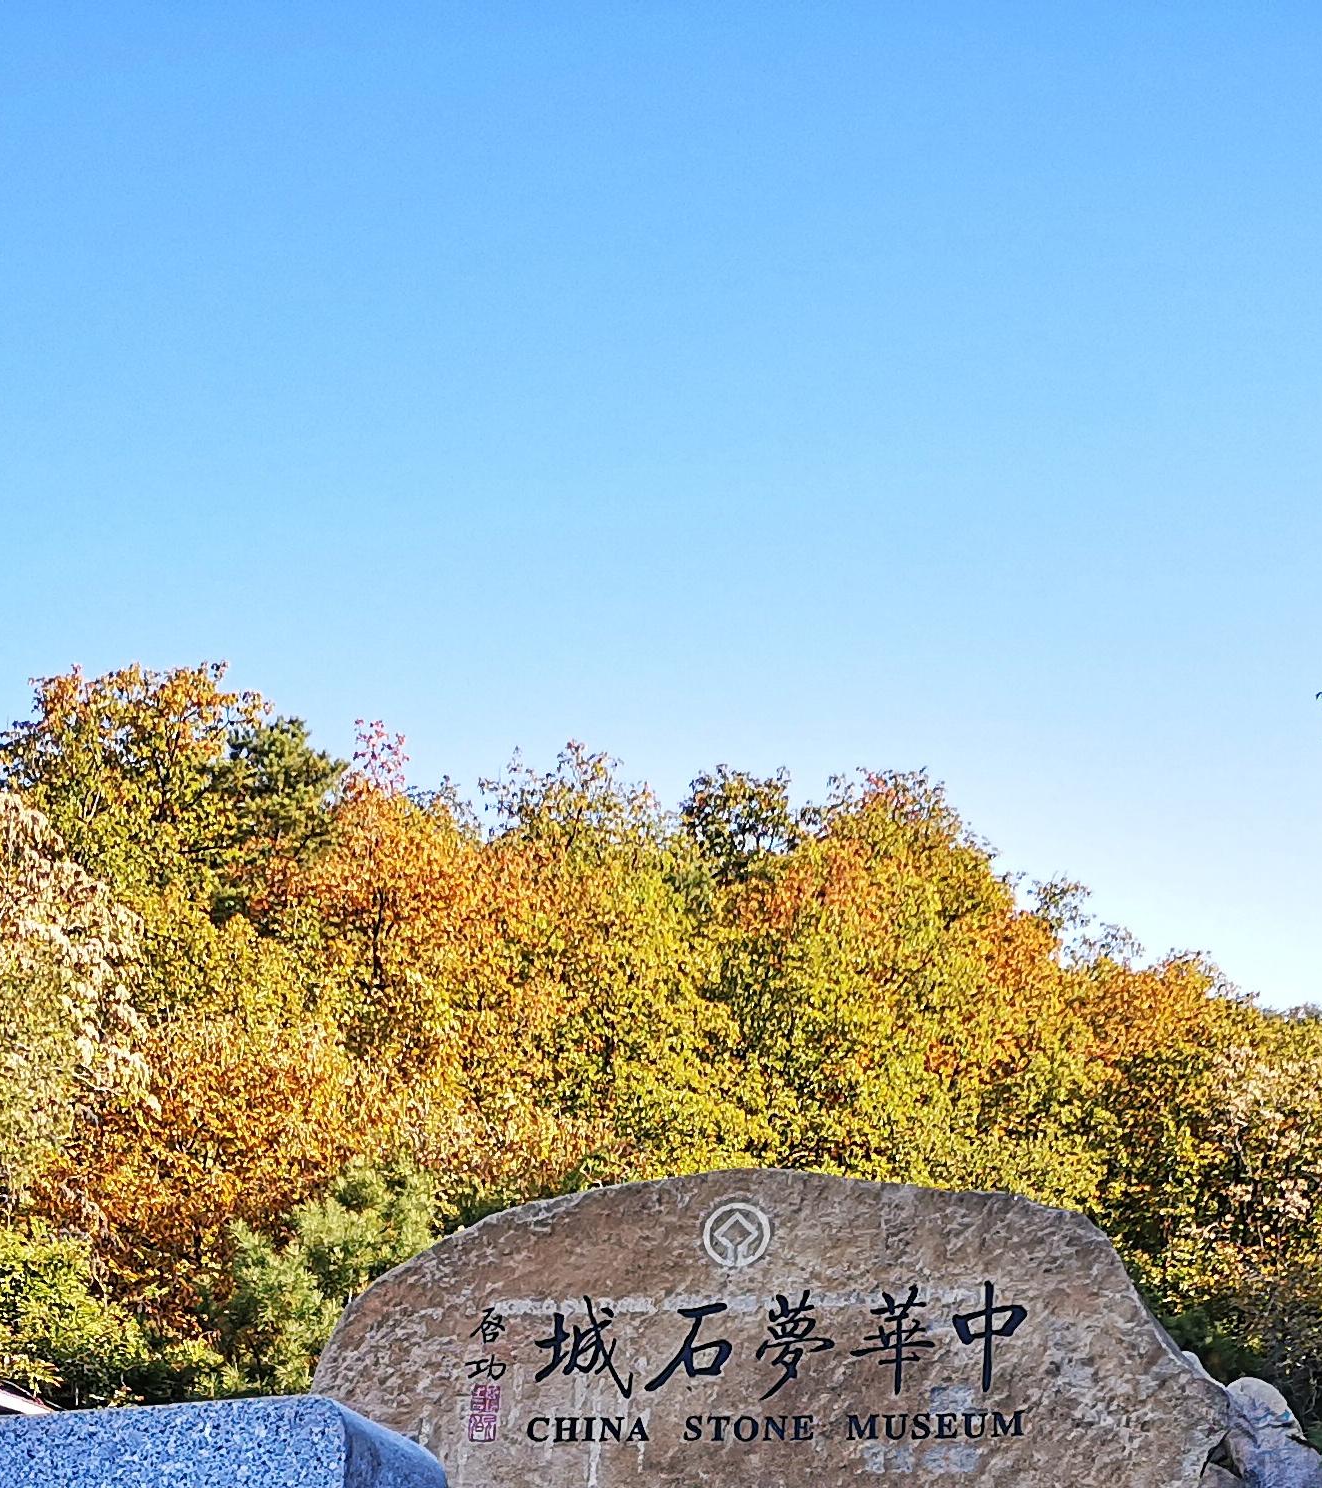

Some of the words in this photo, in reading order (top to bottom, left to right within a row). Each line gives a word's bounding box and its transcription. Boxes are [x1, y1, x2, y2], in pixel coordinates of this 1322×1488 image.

[526, 1415, 650, 1443] CHINA
[683, 1414, 815, 1442] STONE
[847, 1409, 1025, 1441] MUSEUM
